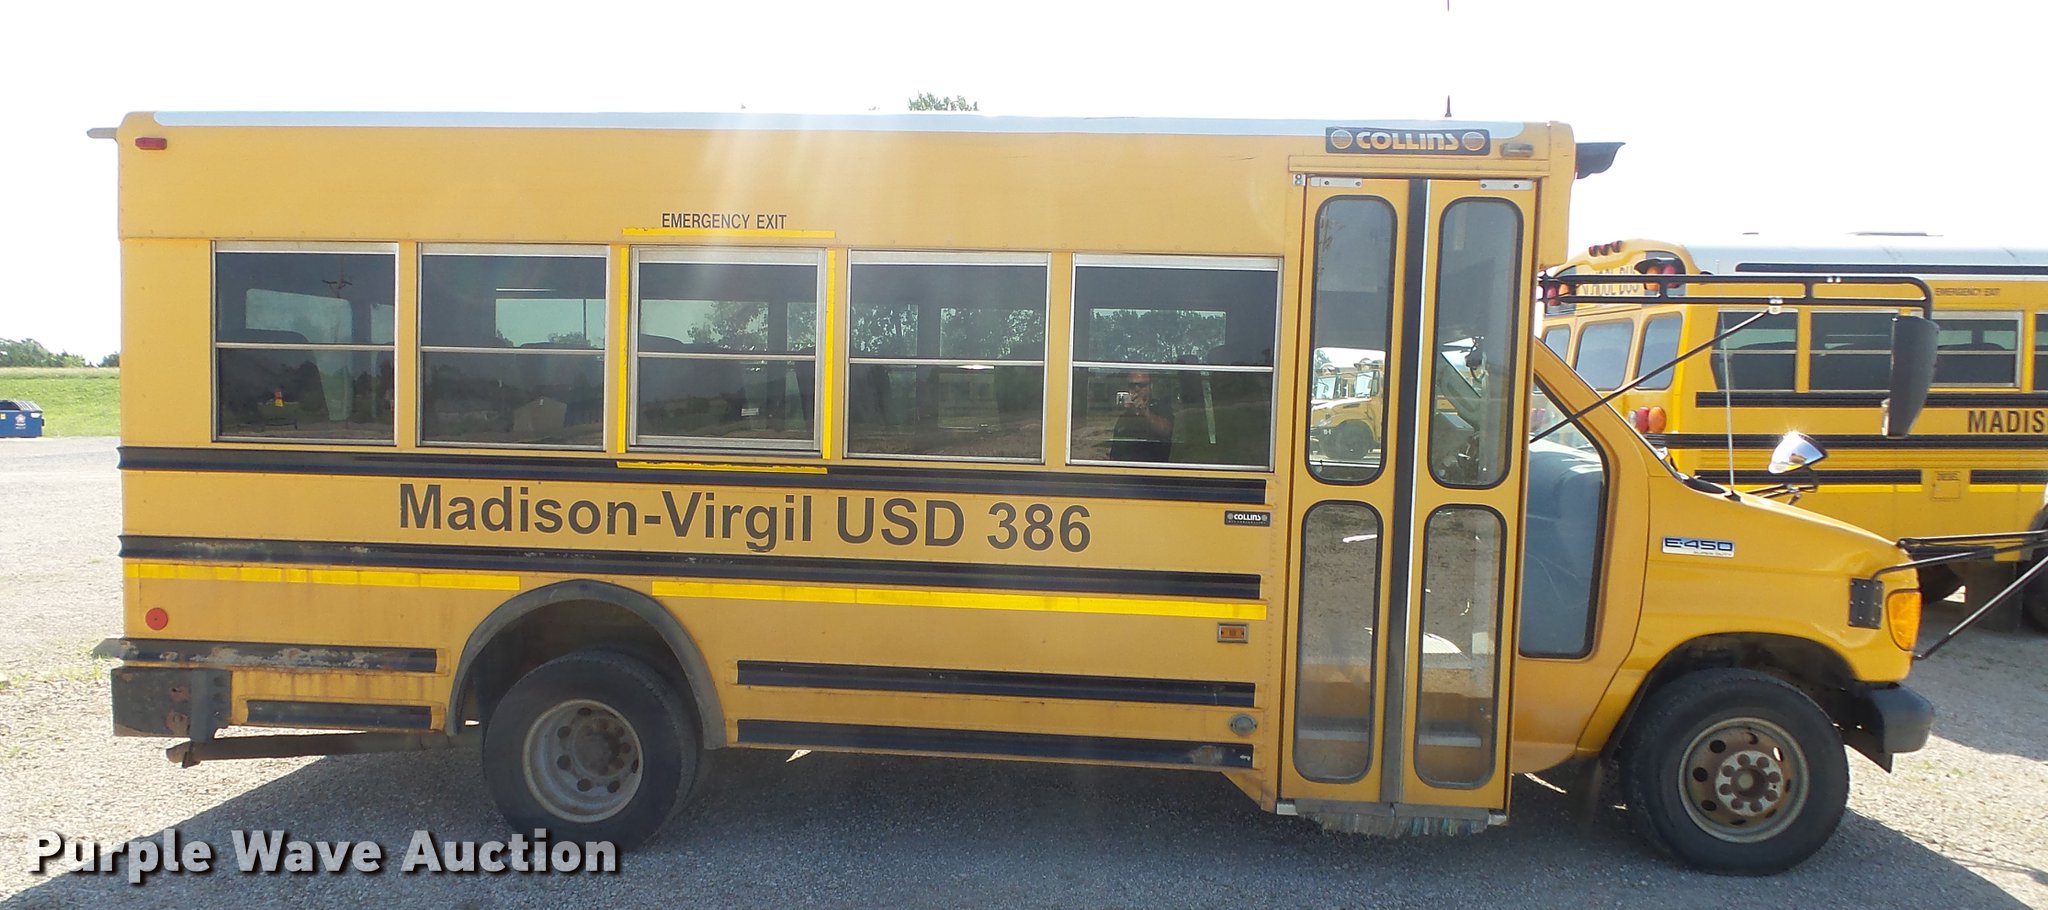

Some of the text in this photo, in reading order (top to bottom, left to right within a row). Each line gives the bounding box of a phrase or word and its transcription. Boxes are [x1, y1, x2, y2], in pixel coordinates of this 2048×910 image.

[1356, 131, 1459, 151] COLLINS
[661, 213, 788, 229] EMERGENCY EXIT
[1967, 410, 2045, 433] MADIS
[399, 483, 1092, 552] Madison-Virgil USD 386
[1233, 513, 1262, 521] COLLINS
